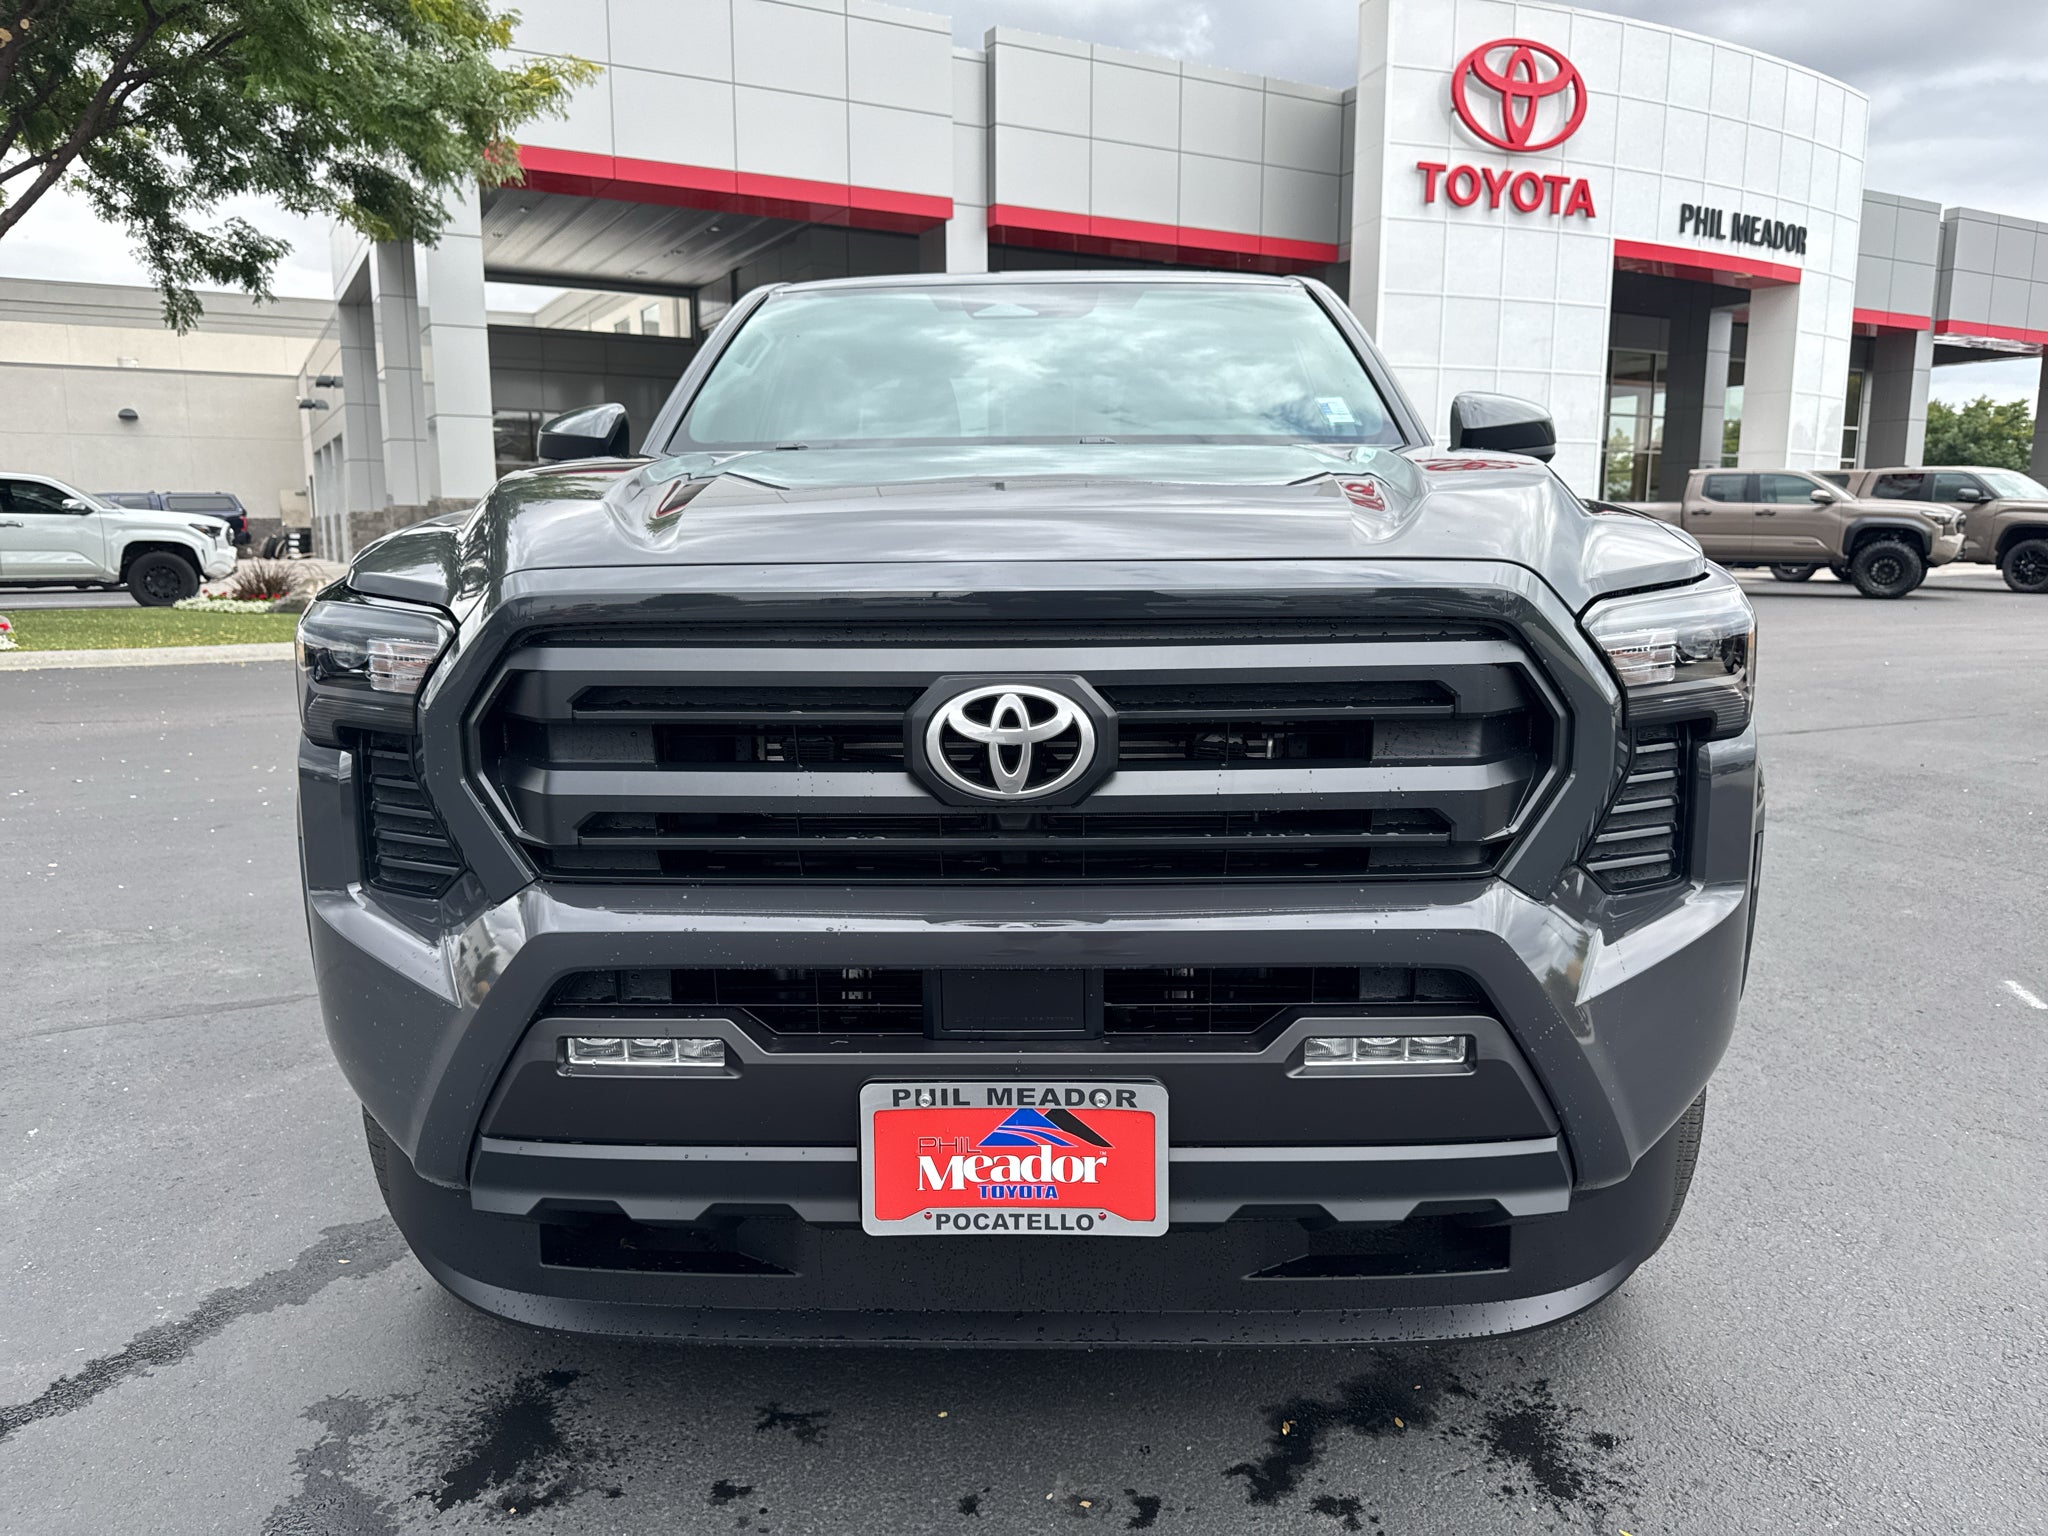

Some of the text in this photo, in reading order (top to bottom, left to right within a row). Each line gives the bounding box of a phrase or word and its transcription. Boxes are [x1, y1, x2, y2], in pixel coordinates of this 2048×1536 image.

[1417, 162, 1596, 219] TOYOTA
[1679, 203, 1808, 256] PHIL MEADOR
[892, 1088, 1137, 1108] PHIL MEADOR
[917, 1137, 982, 1154] PHIL
[916, 1144, 1107, 1191] Meador
[979, 1185, 1059, 1199] TOYOTA
[935, 1213, 1095, 1231] POCATELLO
